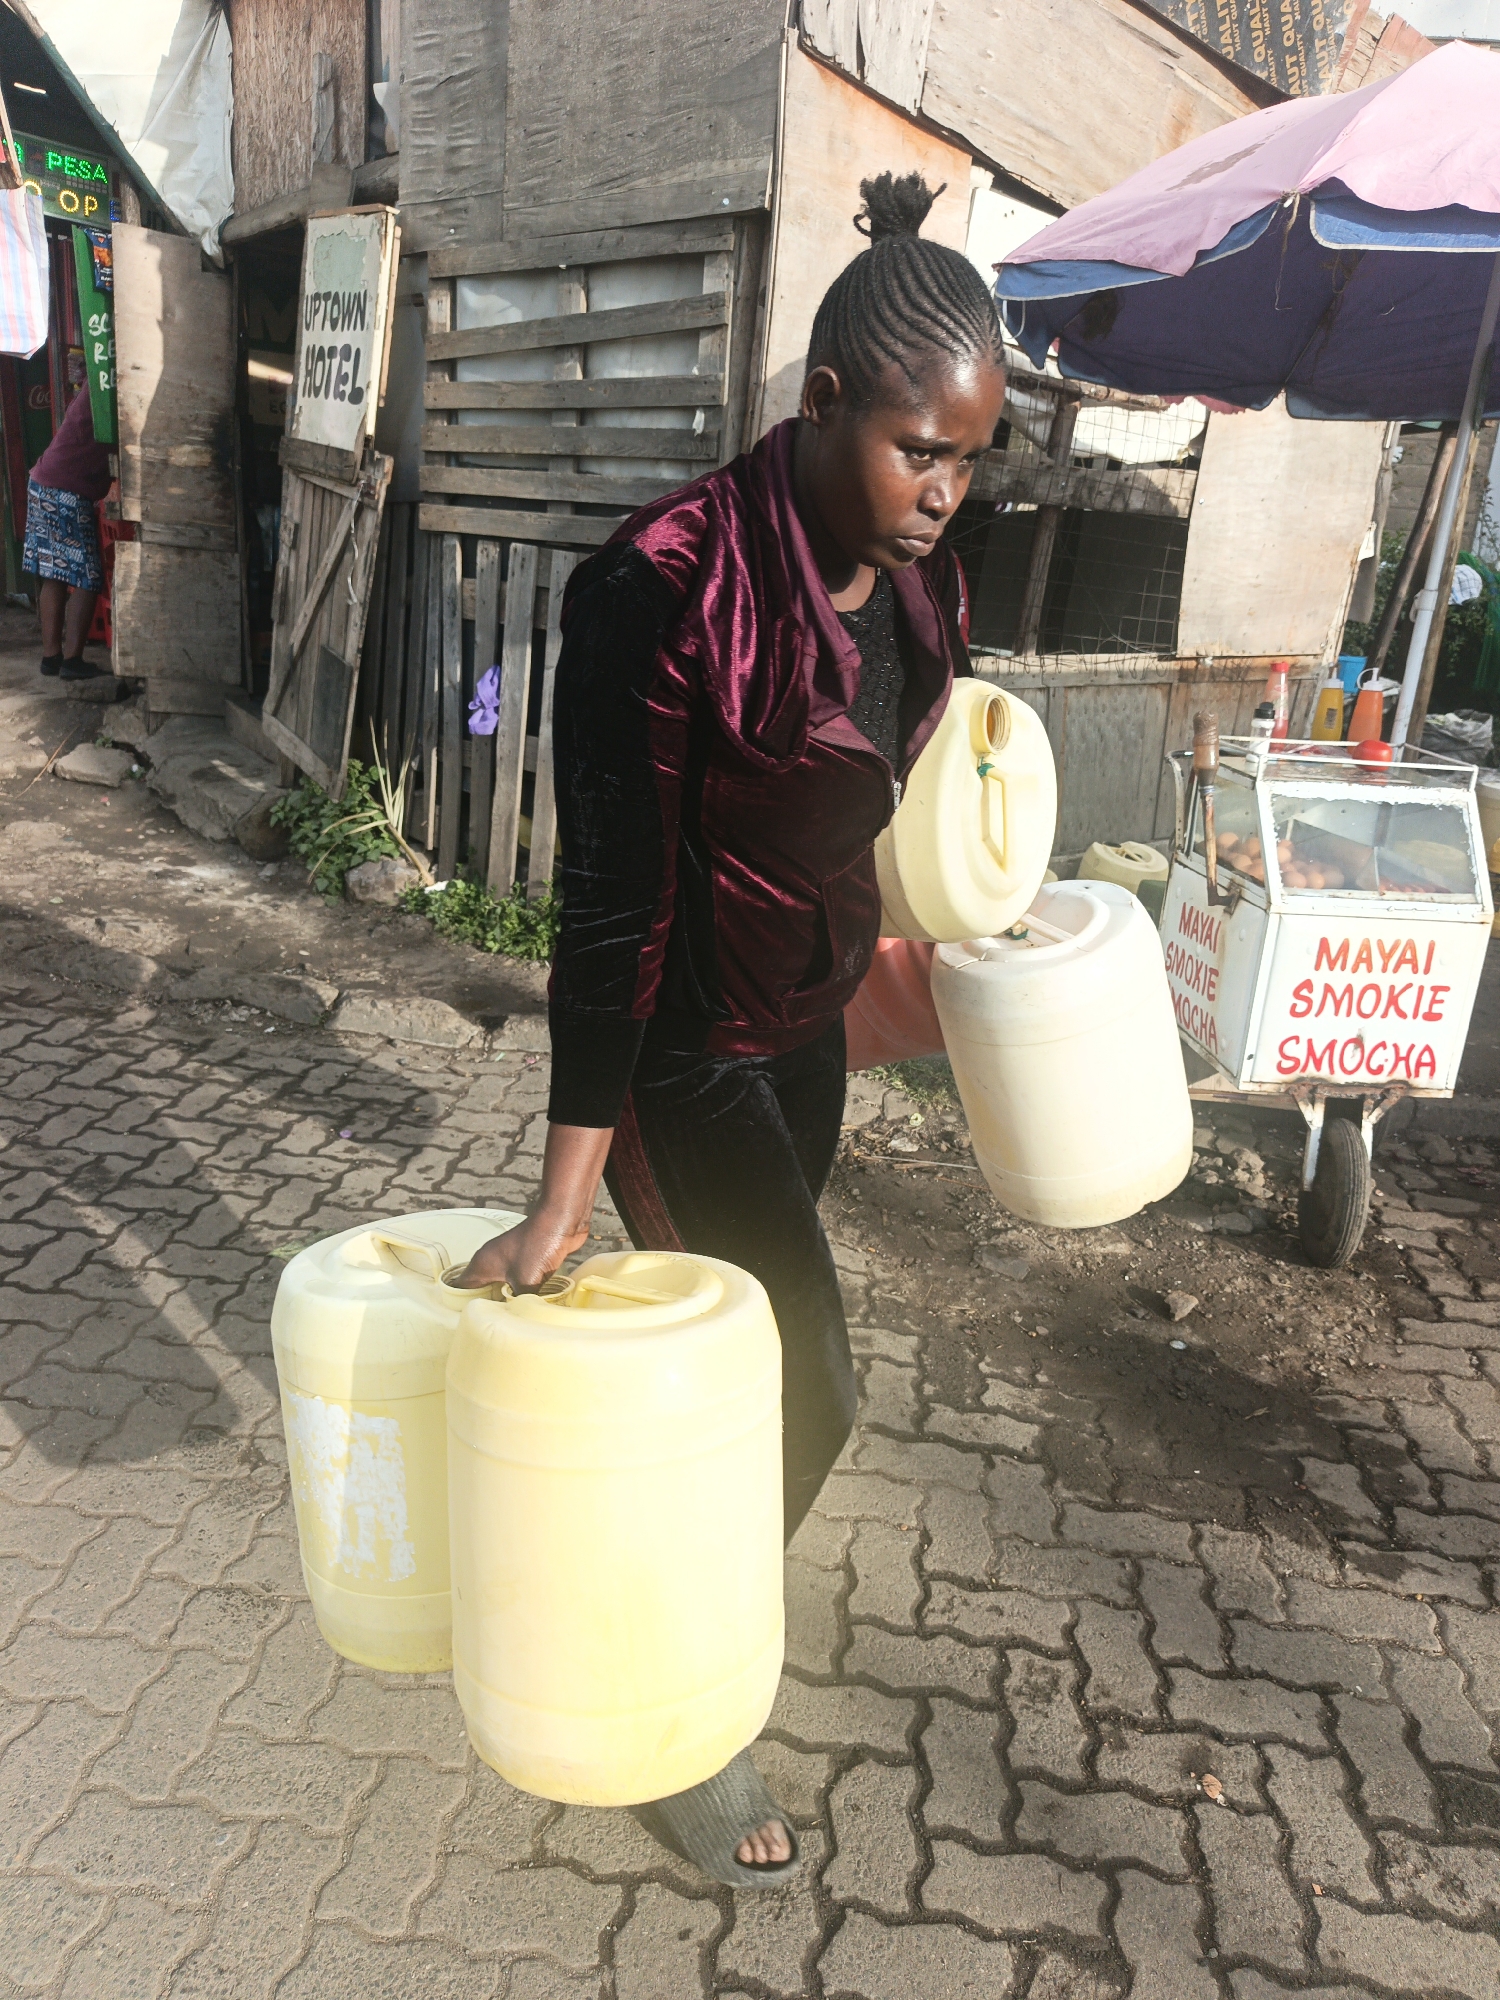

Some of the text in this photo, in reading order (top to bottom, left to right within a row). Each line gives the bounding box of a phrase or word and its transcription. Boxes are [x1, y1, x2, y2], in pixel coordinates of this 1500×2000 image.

[1216, 0, 1234, 61] UALIT
[1267, 49, 1278, 87] UALITY
[1296, 33, 1307, 76] QUALITY
[46, 151, 109, 184] PESA
[303, 289, 368, 332] UPTOWN
[302, 343, 365, 405] HOTEL
[1178, 902, 1222, 954] MAYAI
[1165, 941, 1219, 1002] SMOKIE
[1314, 937, 1436, 975] MAYAI
[1168, 979, 1219, 1054] MOCHA
[1289, 978, 1451, 1022] SMOKIE
[1276, 1035, 1436, 1079] SMOCHA
